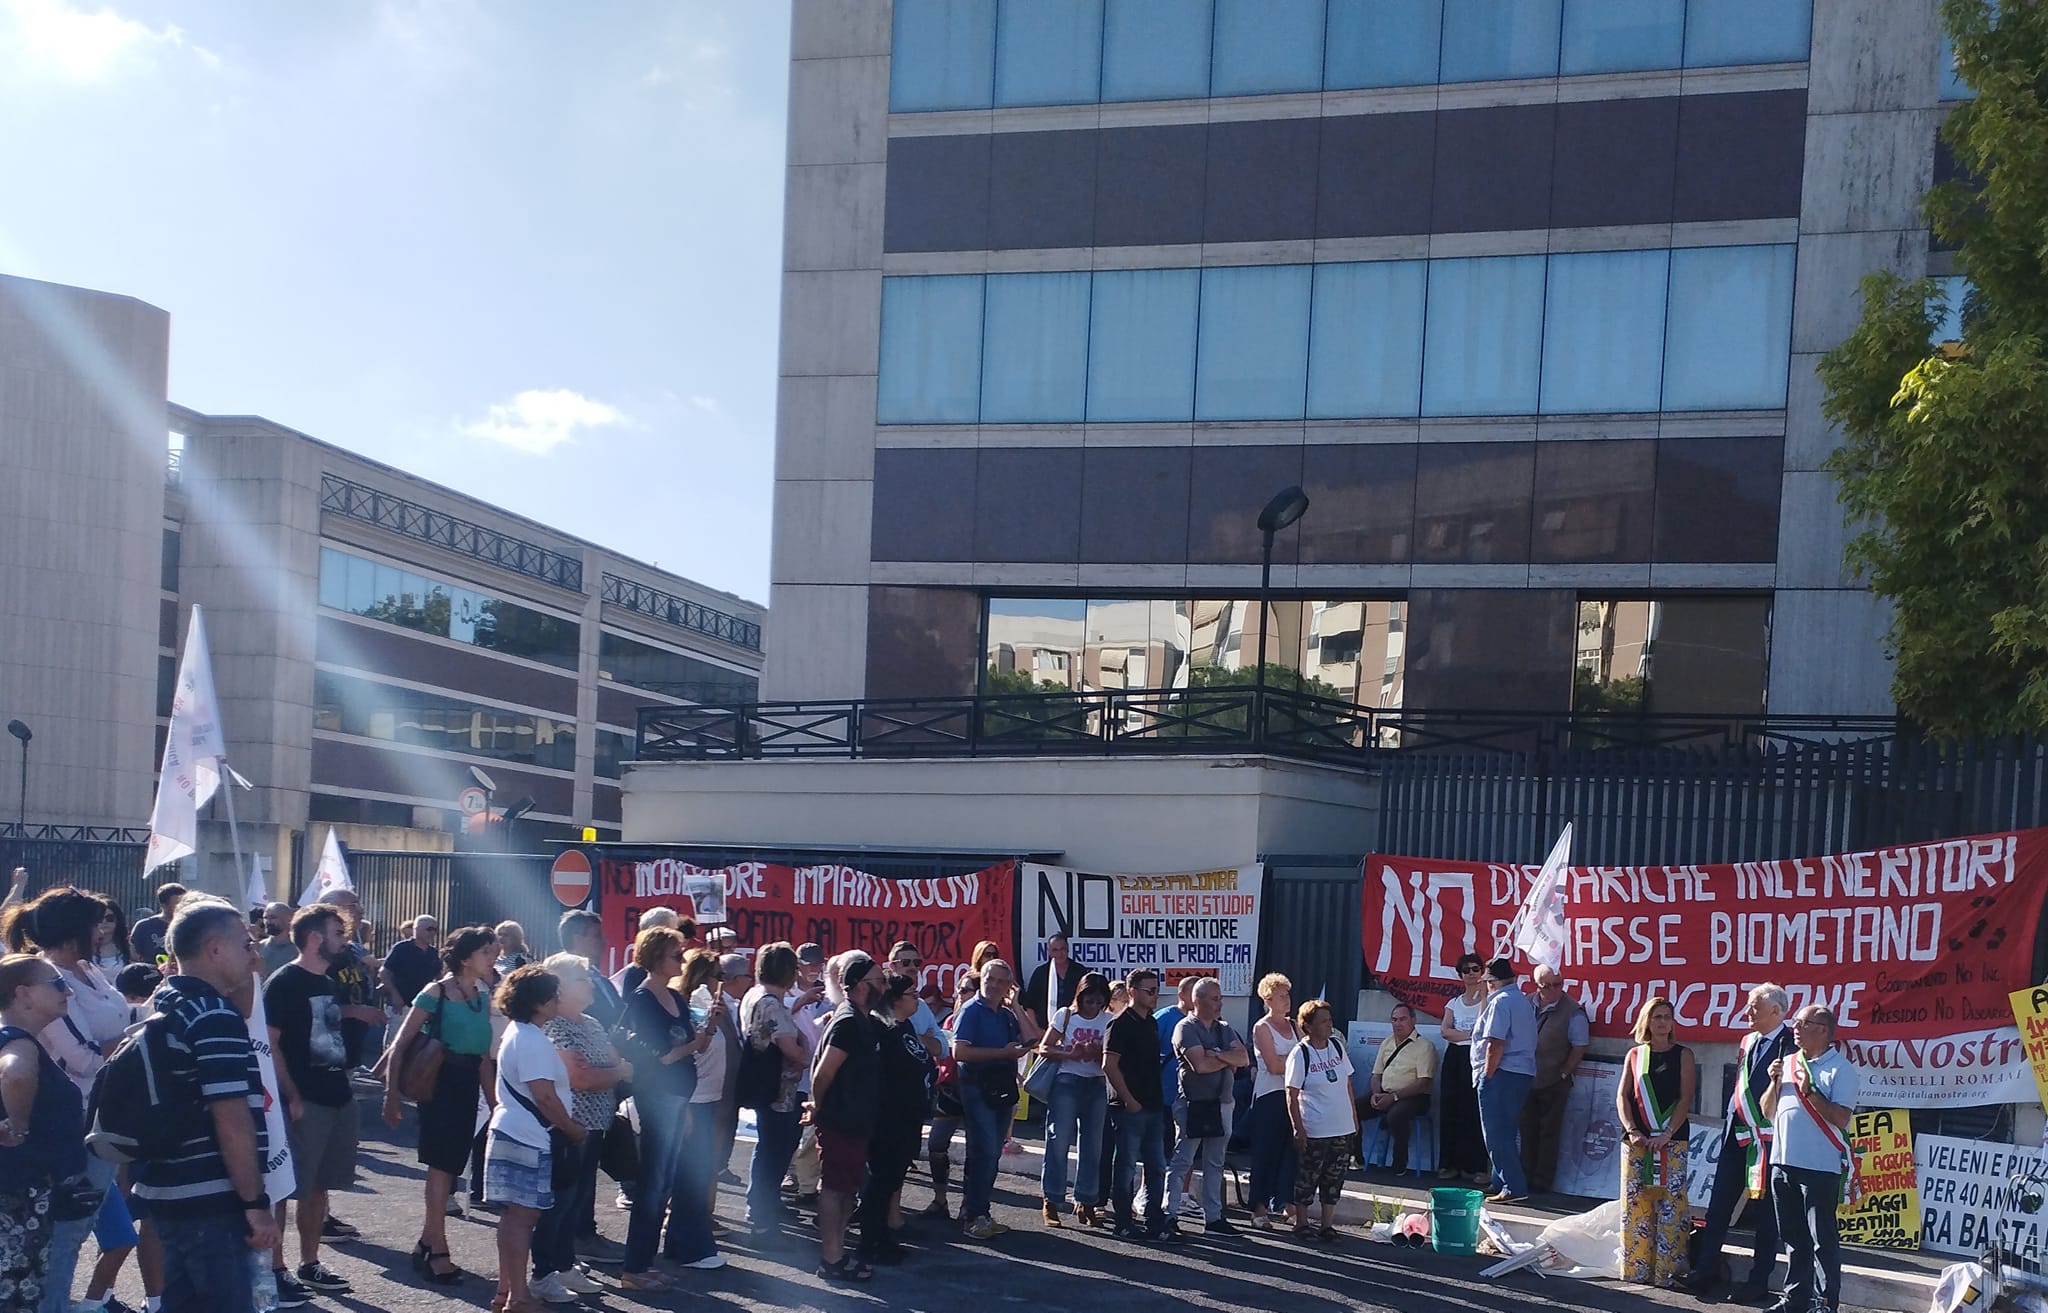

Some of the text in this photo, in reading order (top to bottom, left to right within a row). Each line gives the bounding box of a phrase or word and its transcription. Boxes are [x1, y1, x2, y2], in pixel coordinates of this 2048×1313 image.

[633, 857, 768, 899] INCENEORE
[1733, 836, 2018, 899] INCENERITORI
[1038, 871, 1115, 939] NO
[1121, 894, 1255, 916] GUALTIERI STUDIA
[1119, 918, 1239, 940] L'INCENERITORE
[1375, 864, 1478, 982] NO
[1710, 901, 1943, 966] BIOMETANO
[1161, 943, 1175, 963] IL
[1178, 943, 1252, 965] PROBLEMA
[1869, 1068, 2023, 1087] CASTELLI ROMANI
[1873, 1152, 1915, 1172] ACQUA
[1929, 1145, 1988, 1175] VELENI
[1991, 1153, 2003, 1177] E
[1923, 1176, 1956, 1204] PER
[1959, 1182, 1979, 1207] 40
[1873, 1228, 1905, 1238] UNA
